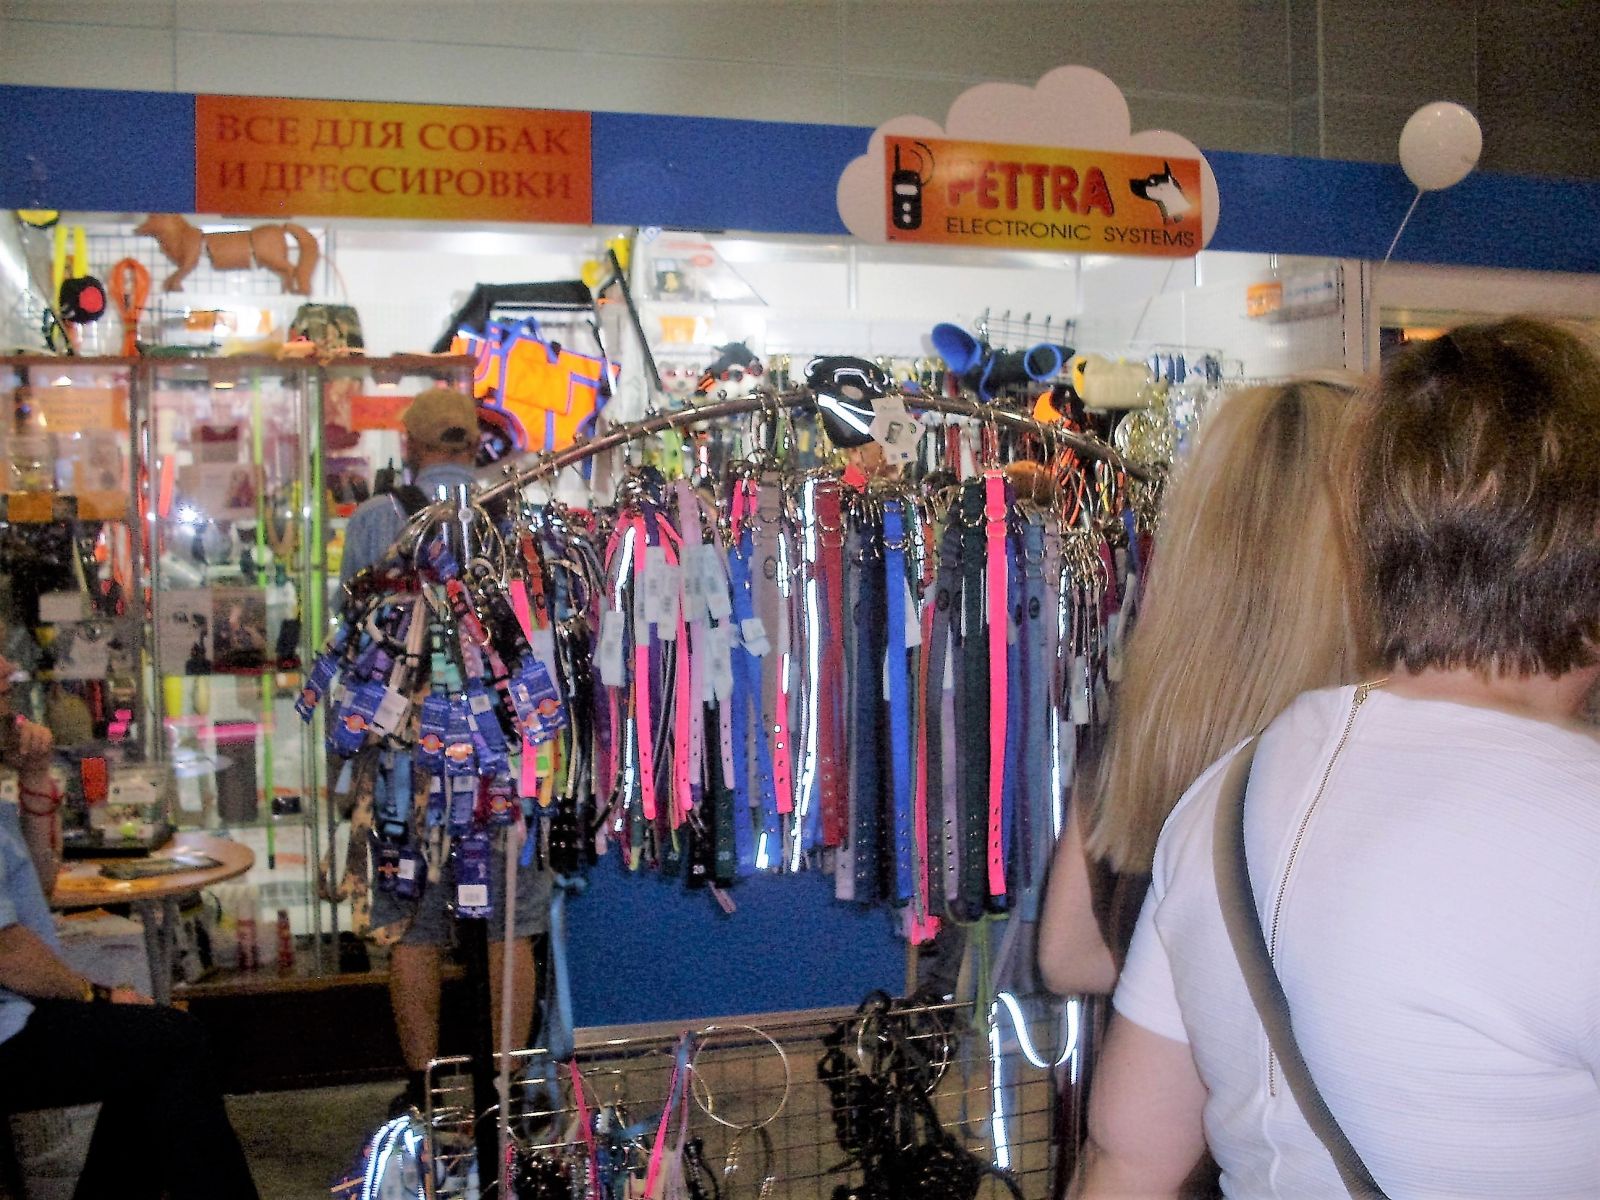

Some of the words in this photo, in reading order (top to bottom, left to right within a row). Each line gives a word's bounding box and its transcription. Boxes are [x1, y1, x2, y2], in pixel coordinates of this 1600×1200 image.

[216, 114, 300, 146] ВСЕ
[310, 118, 405, 153] ДЛЯ
[418, 121, 571, 156] СОБАК
[216, 160, 247, 191] И
[259, 161, 573, 200] ДРЕССИРОВКИ
[947, 160, 1115, 218] PETTRA
[946, 216, 1092, 242] ELECTRONIC
[1103, 226, 1195, 247] SYSTEMS
